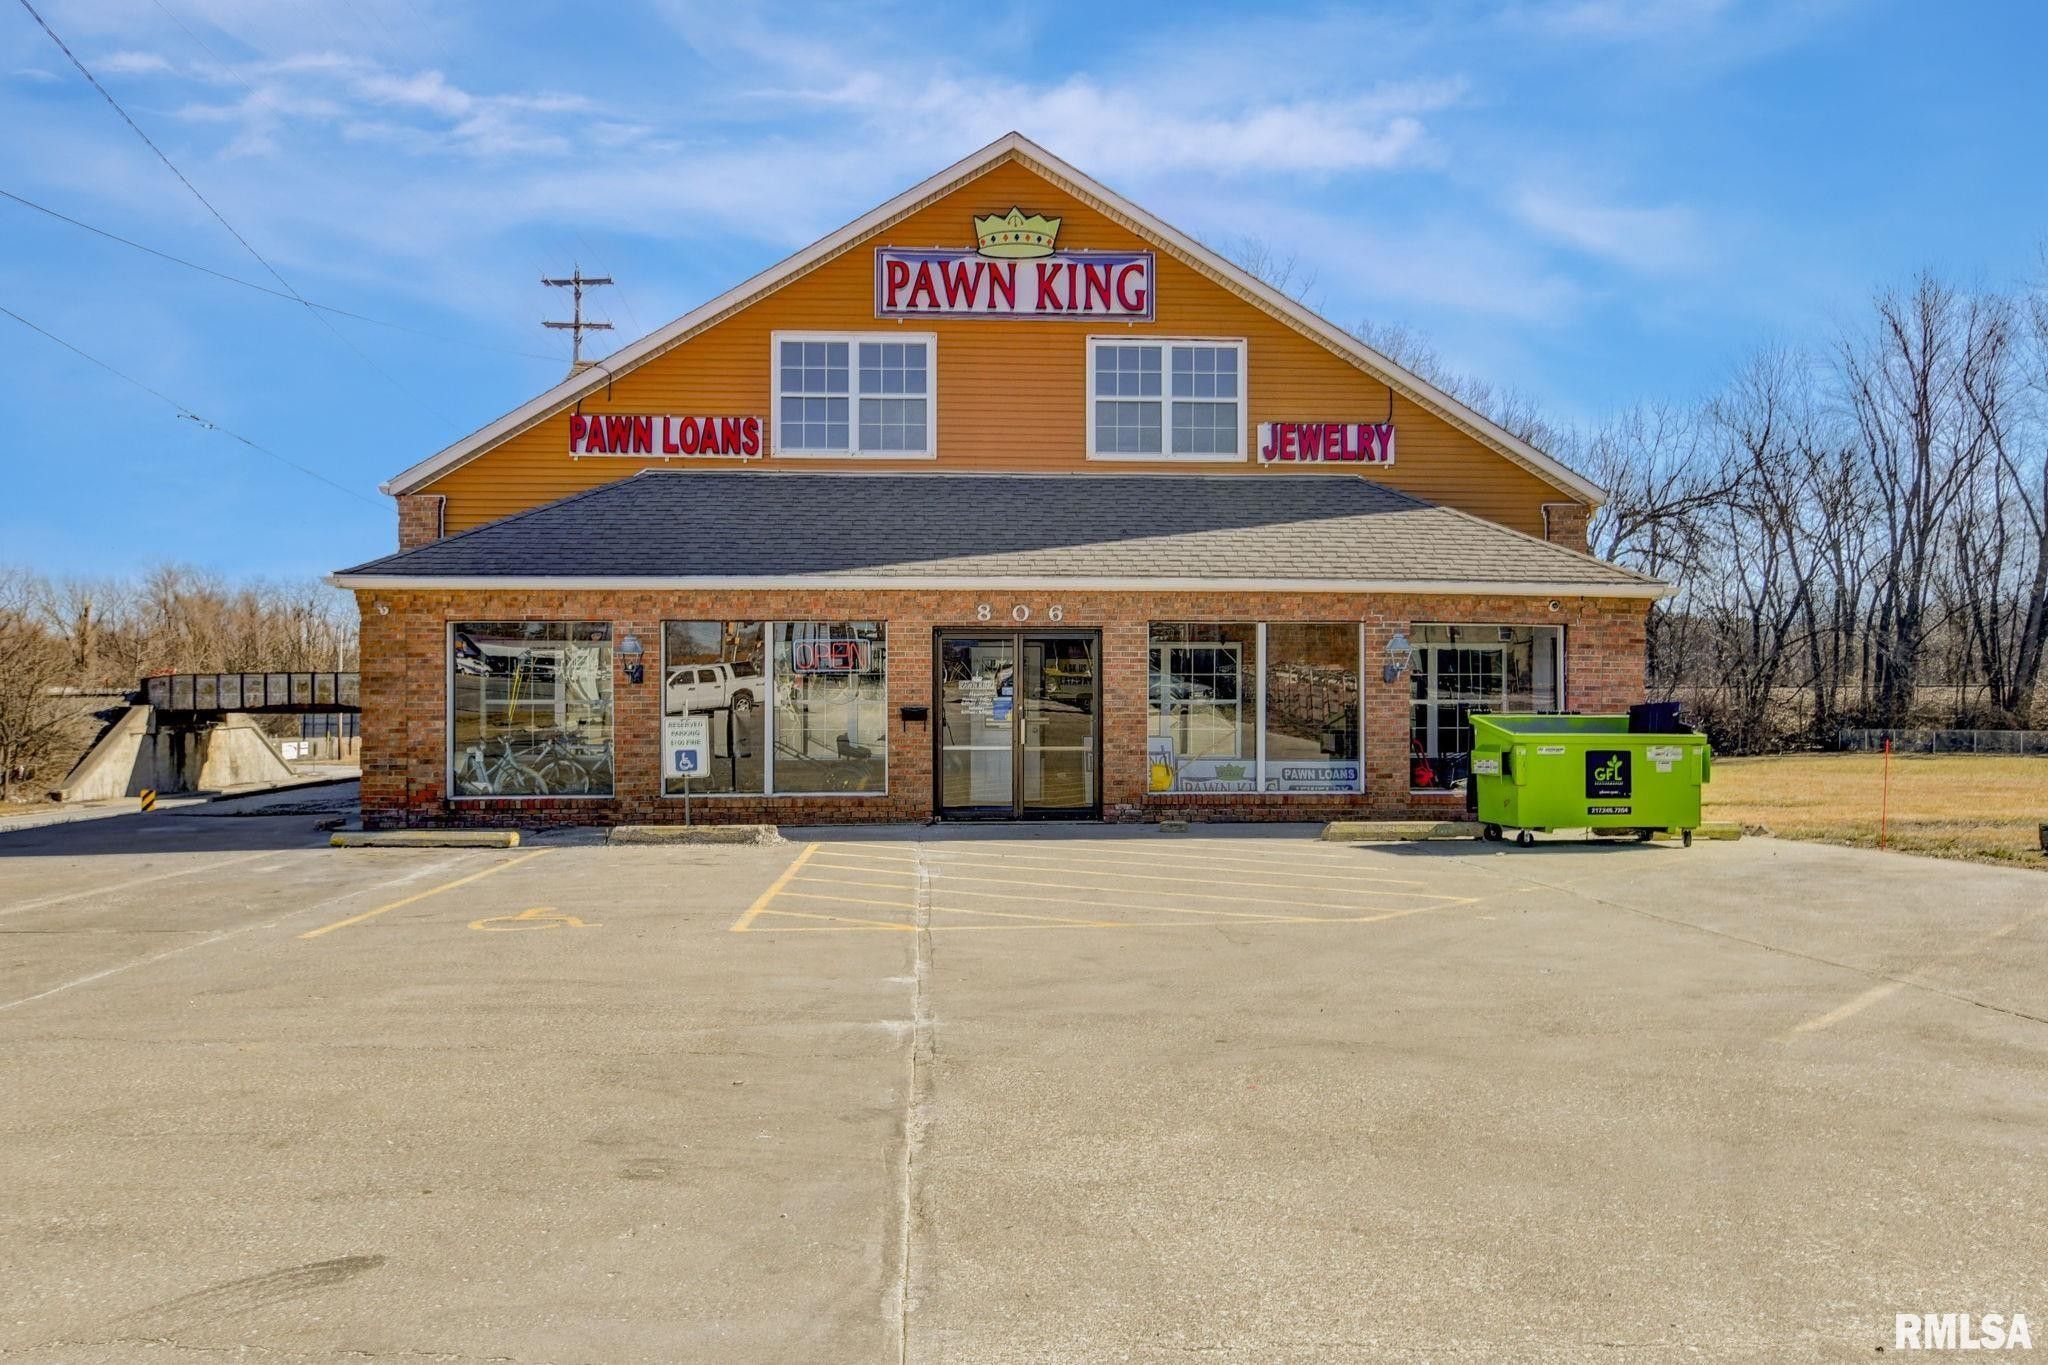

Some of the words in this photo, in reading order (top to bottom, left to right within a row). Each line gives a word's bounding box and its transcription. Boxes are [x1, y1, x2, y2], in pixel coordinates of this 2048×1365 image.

[886, 260, 1017, 309] PAWN
[1035, 262, 1146, 312] KING
[570, 415, 653, 453] PAWN
[663, 416, 760, 455] LOANS
[1262, 423, 1394, 462] JEWELRY
[796, 642, 868, 670] OPEN
[1284, 769, 1315, 780] PAWN
[1318, 769, 1355, 780] LOANS
[1594, 767, 1623, 781] GFL
